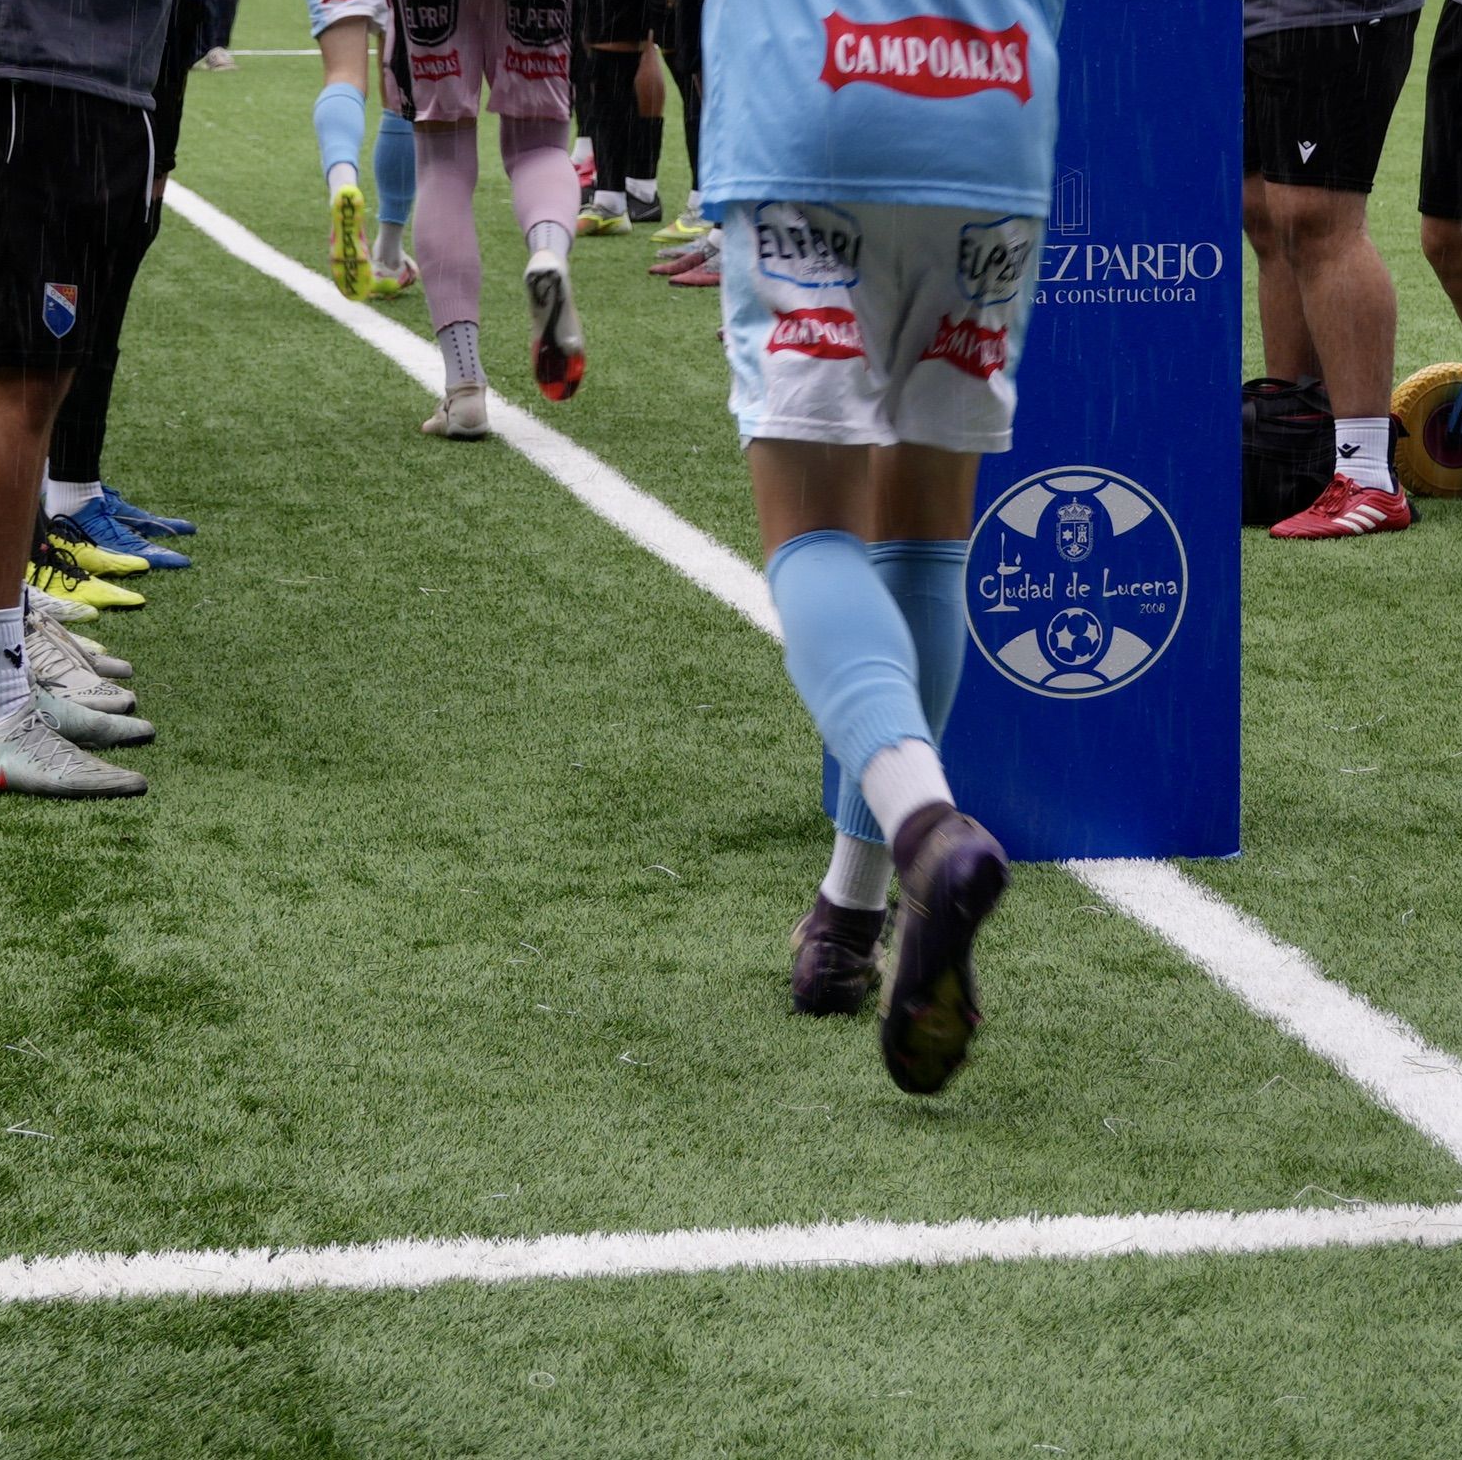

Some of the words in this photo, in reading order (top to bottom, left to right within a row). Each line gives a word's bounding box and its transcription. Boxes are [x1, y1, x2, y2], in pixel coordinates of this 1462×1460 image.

[833, 32, 1024, 85] CAMPOARAS
[1085, 242, 1224, 286] PAREJO
[1054, 286, 1196, 304] constructora
[1066, 572, 1091, 601] de
[1102, 567, 1179, 597] Lucena
[1139, 602, 1167, 614] 2008
